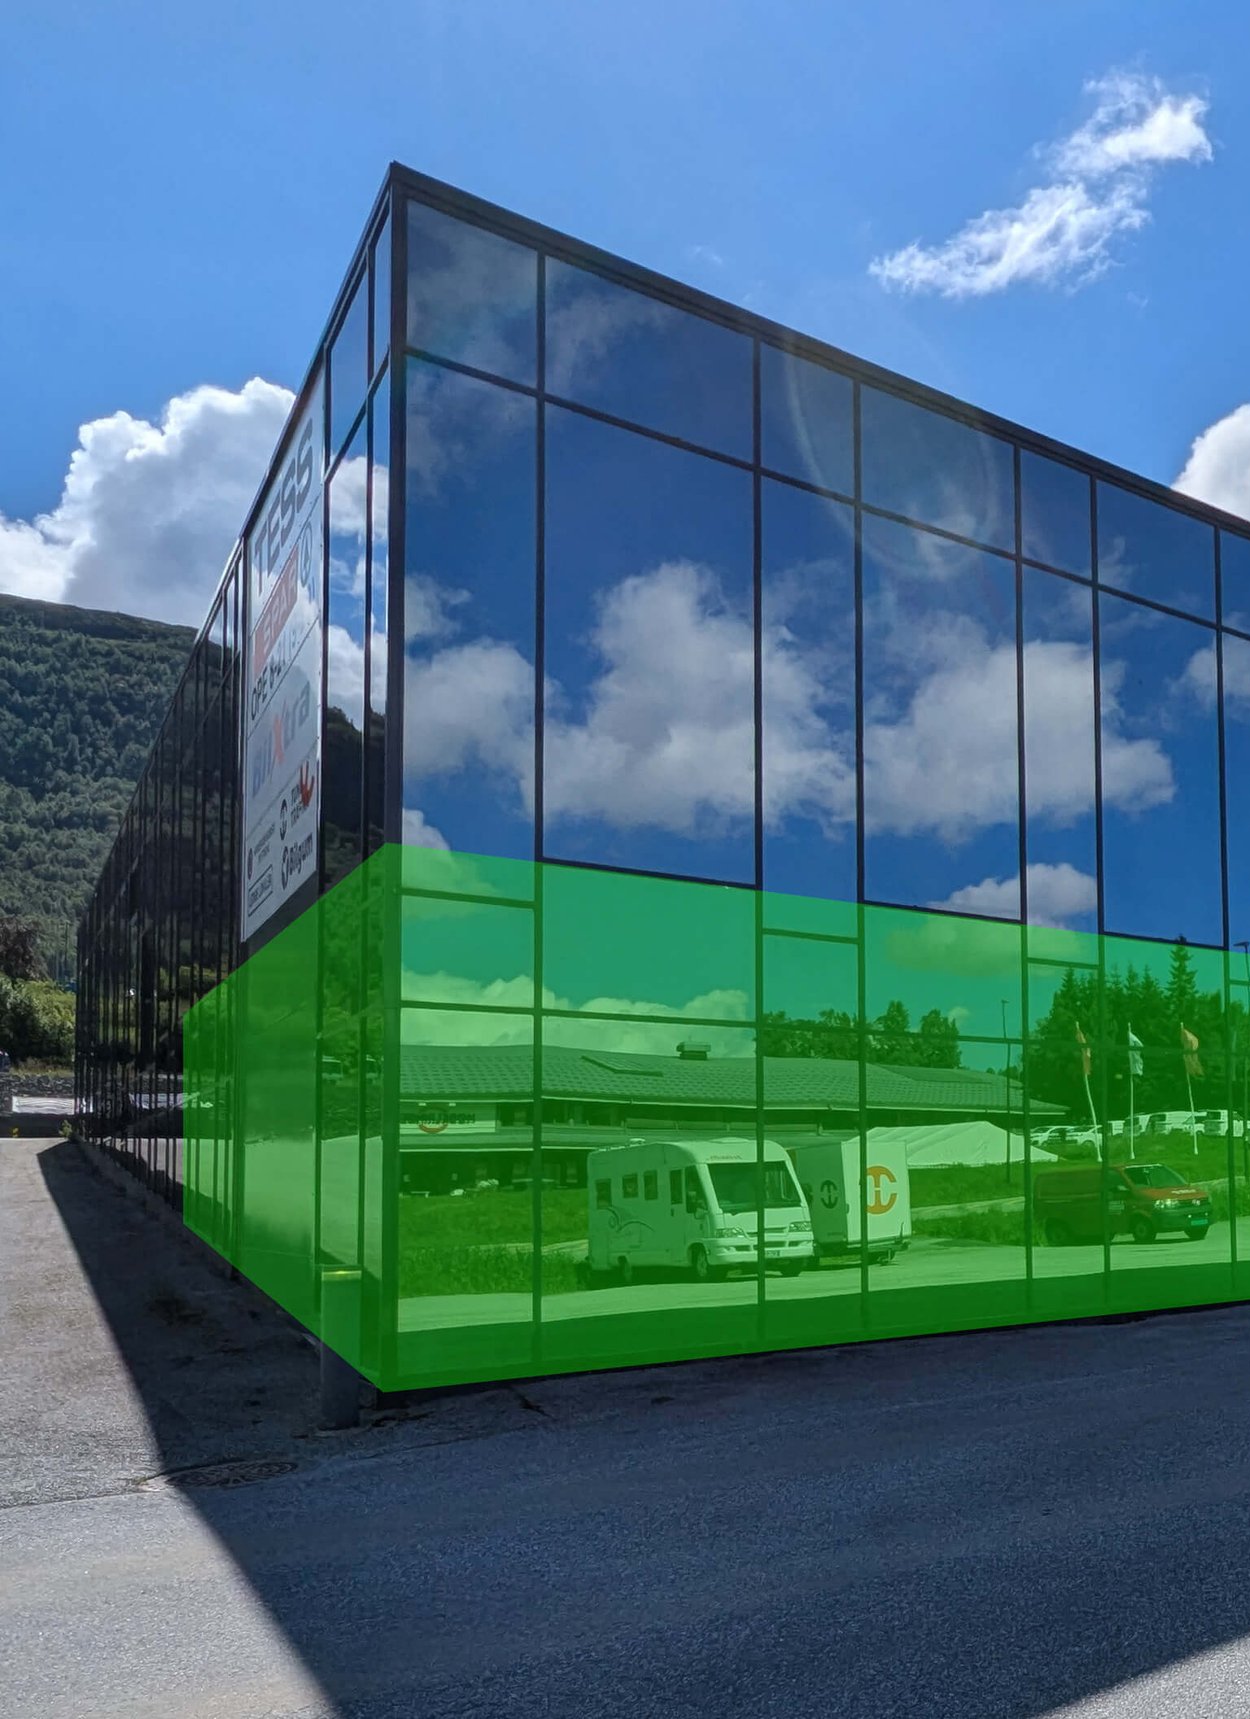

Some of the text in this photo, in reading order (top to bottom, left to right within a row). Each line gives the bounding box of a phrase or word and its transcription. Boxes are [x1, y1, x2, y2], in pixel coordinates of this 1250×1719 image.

[255, 419, 313, 597] TESS
[264, 562, 297, 652] SPAR
[252, 681, 310, 797] BilXtra
